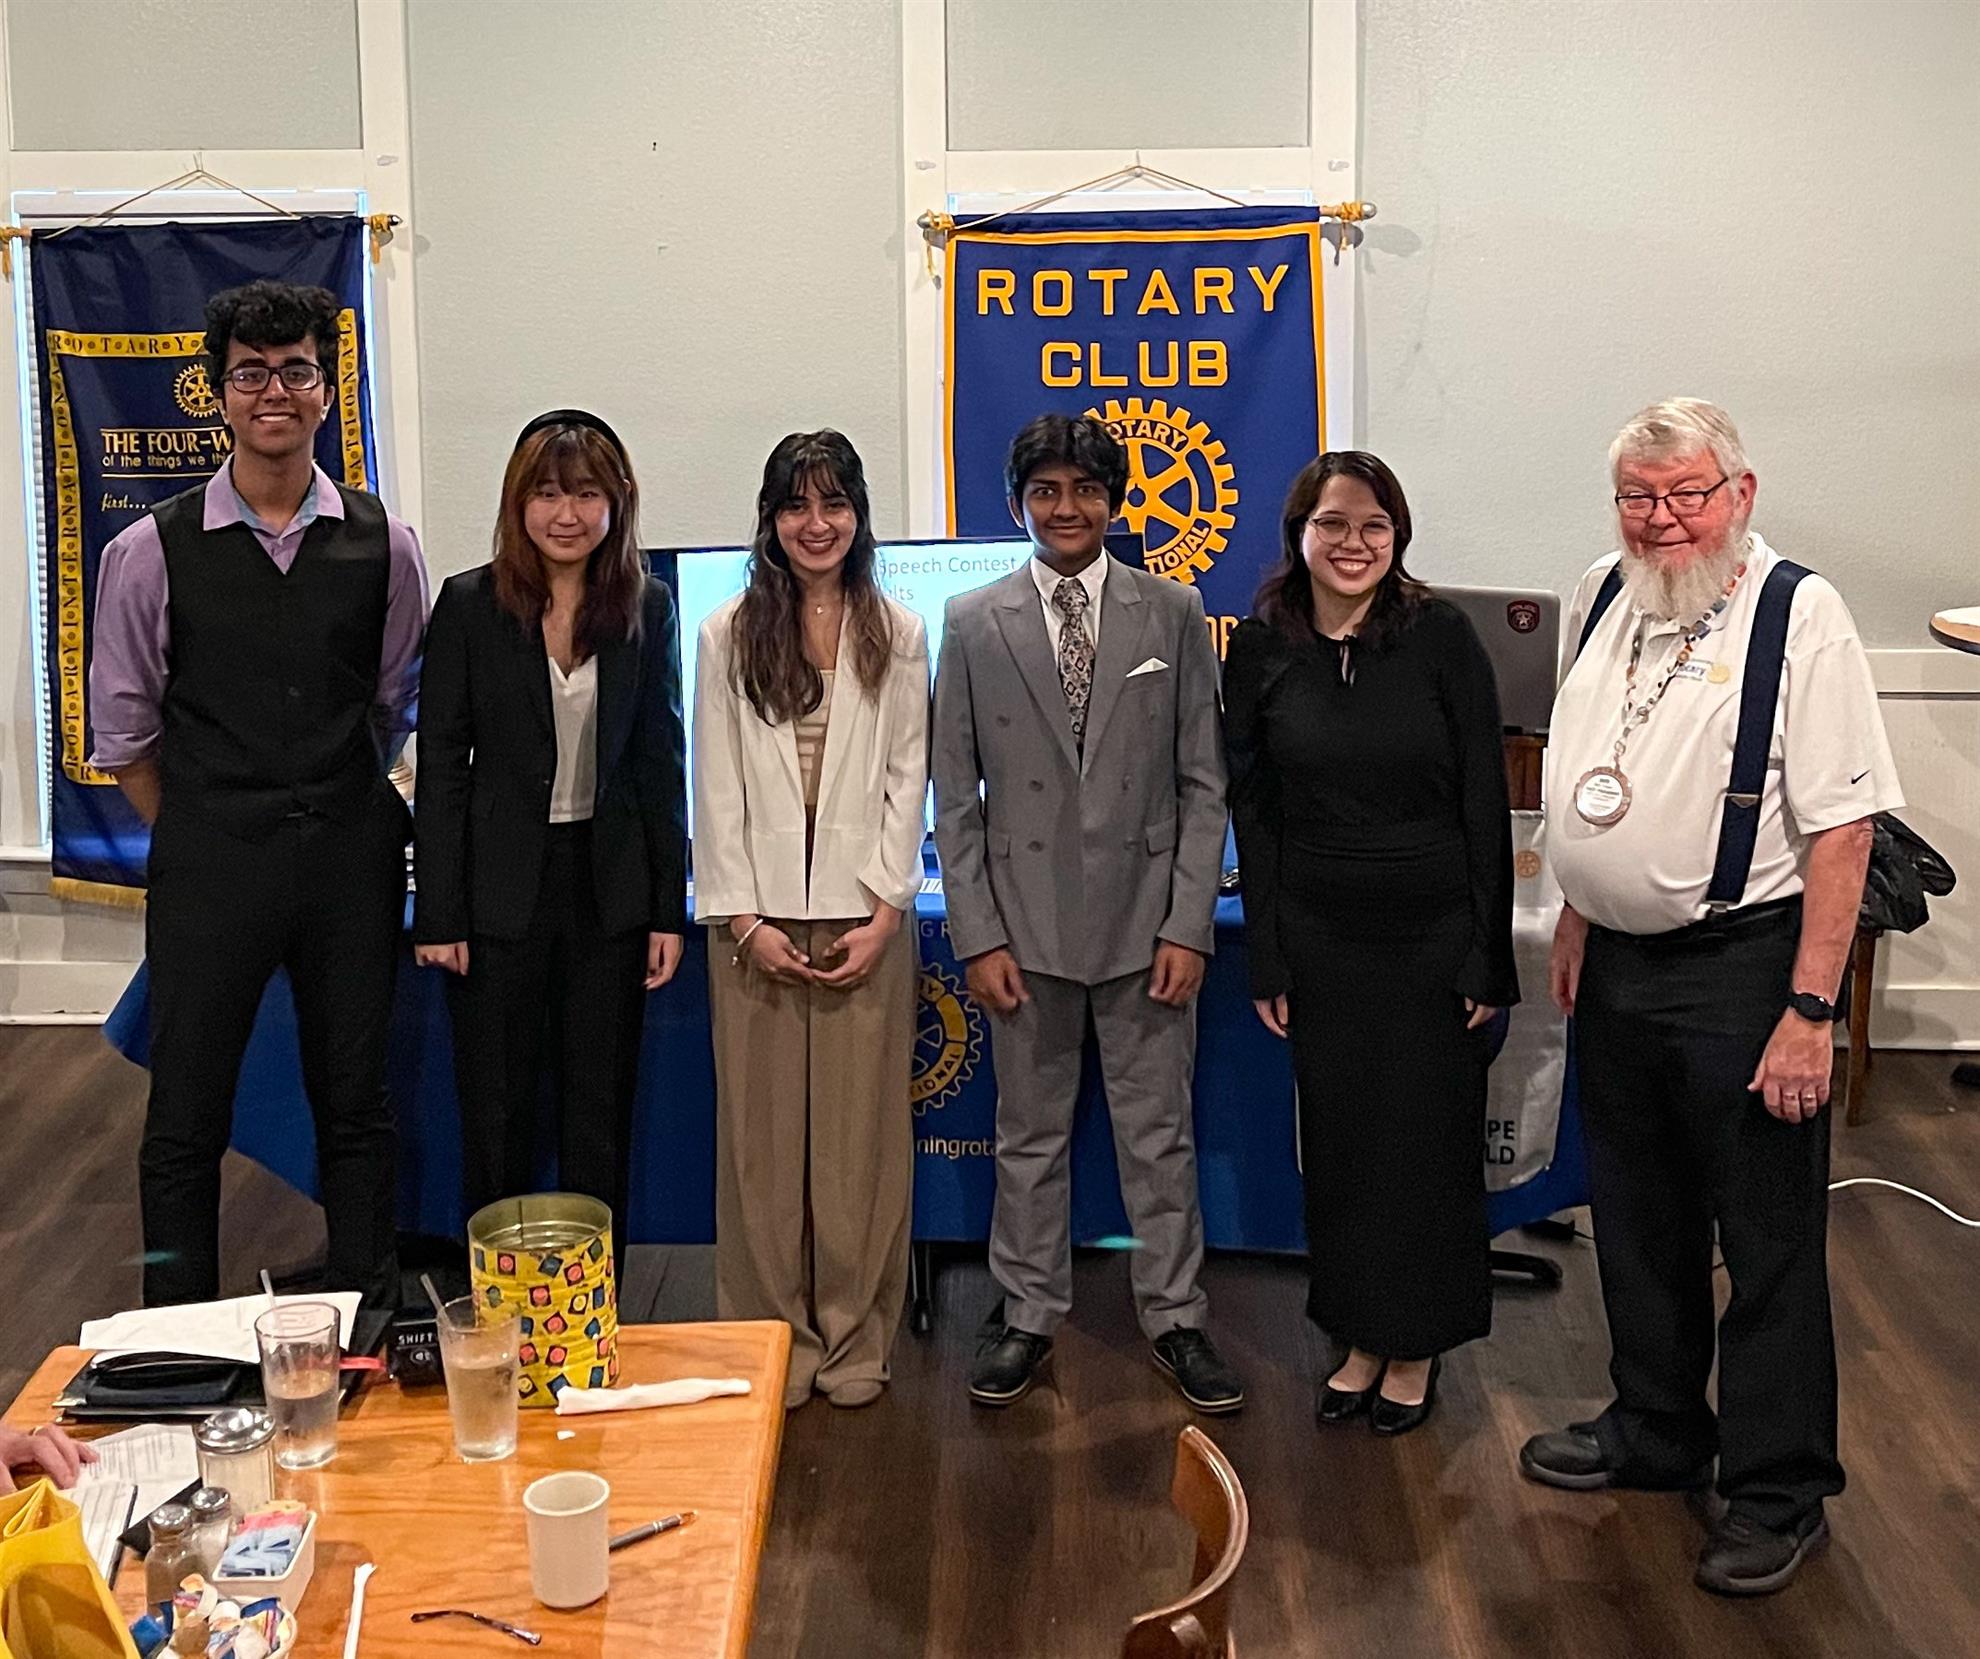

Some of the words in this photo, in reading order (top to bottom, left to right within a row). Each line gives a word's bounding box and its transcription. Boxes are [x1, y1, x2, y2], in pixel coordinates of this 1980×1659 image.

[977, 264, 1290, 317] ROTARY
[51, 333, 186, 353] ROTARY
[1041, 340, 1229, 387] CLUB
[101, 431, 140, 453] THE
[1105, 419, 1188, 450] OTARY
[120, 454, 142, 468] the
[147, 455, 182, 470] things
[187, 455, 206, 466] we
[52, 358, 79, 628] INTERNATIONA
[948, 556, 1017, 573] Contest
[1144, 525, 1210, 575] TIONAL
[63, 645, 80, 769] ROTARY
[398, 1331, 433, 1345] SHIFT
